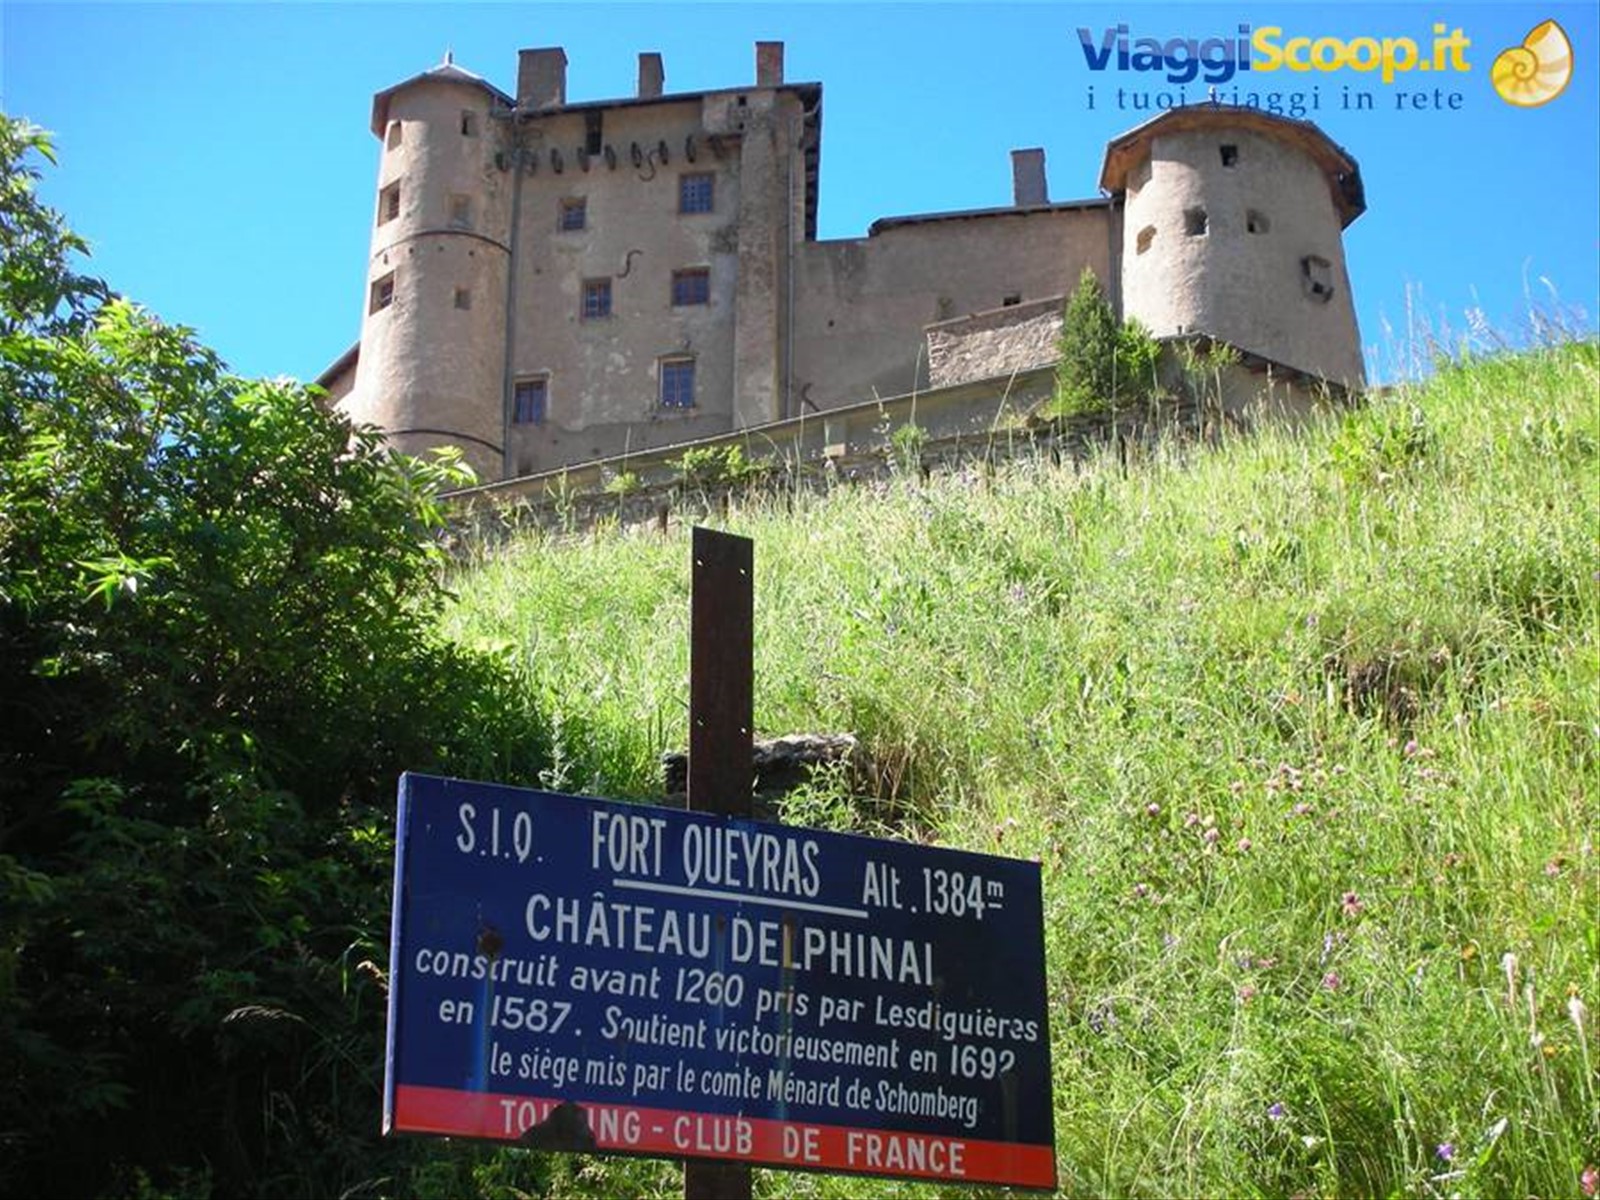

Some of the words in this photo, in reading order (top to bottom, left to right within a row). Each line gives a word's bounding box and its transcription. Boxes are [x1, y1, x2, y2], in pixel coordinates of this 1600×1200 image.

[592, 810, 667, 877] FORT
[682, 823, 820, 898] QUEYRAS
[525, 892, 710, 958] CHÂTEAU
[570, 966, 661, 999] avant
[676, 967, 744, 1008] 1260
[756, 985, 808, 1021] pris
[819, 995, 865, 1026] par
[439, 999, 474, 1025] en
[715, 1022, 900, 1070] victorieusement
[909, 1048, 938, 1073] en
[490, 1042, 512, 1076] le
[518, 1047, 578, 1089] siège
[585, 1056, 626, 1087] mis
[632, 1063, 670, 1096] par
[677, 1060, 696, 1093] le
[700, 1066, 762, 1104] comte
[766, 1069, 840, 1107] Ménard
[846, 1078, 871, 1110] de
[875, 1079, 979, 1128] Schomberg
[500, 1099, 640, 1144] TOING
[673, 1116, 753, 1155] CLUB
[783, 1125, 821, 1162] DE
[847, 1132, 966, 1175] FRANCE
